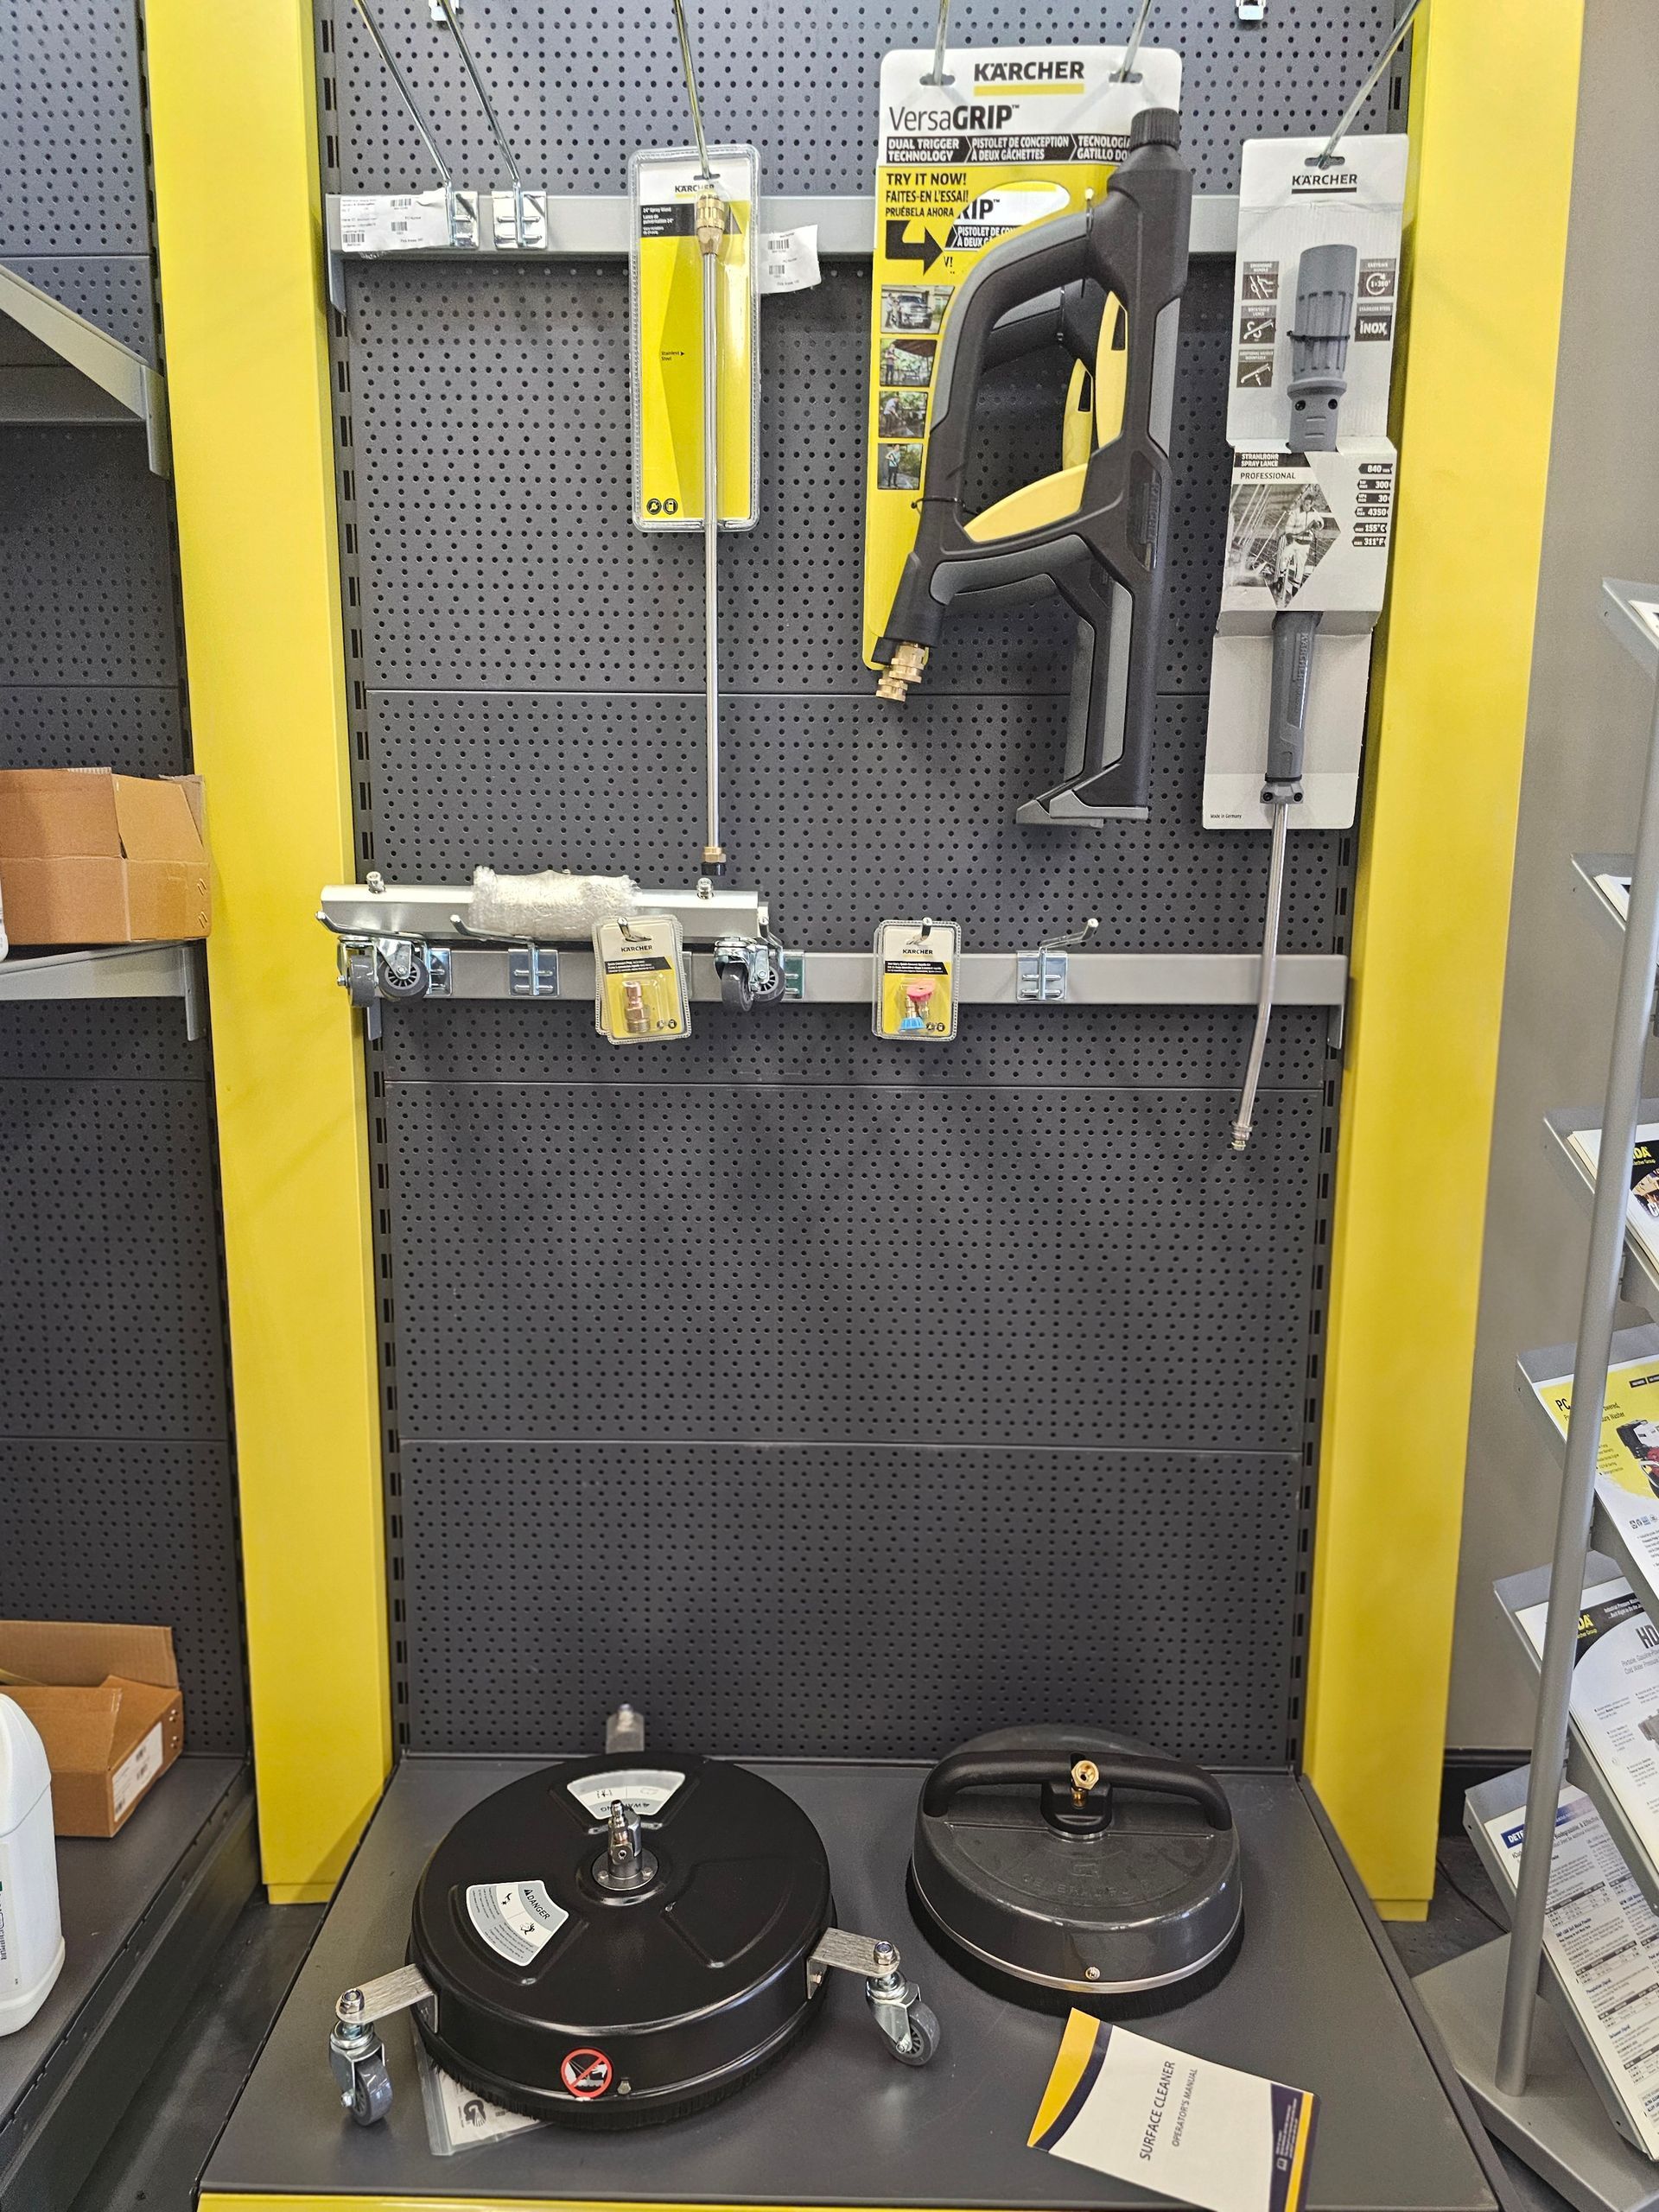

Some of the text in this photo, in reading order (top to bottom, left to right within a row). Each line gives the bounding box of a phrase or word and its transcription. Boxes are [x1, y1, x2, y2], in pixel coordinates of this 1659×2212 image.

[973, 60, 1085, 82] KÄRCHER
[888, 137, 959, 149] DUAL TRIGGER
[971, 136, 1070, 149] PISTOLET DE CONCEPTION
[888, 149, 954, 162] TECHNOLOGY
[979, 149, 1000, 162] DEUX
[1001, 149, 1045, 161] GÂCHETTES
[1077, 148, 1130, 161] GATILLO DO
[887, 173, 966, 185] TRY IT NOW!
[1292, 174, 1357, 186] KÄRCHER
[886, 190, 931, 203] FAITES-EN
[886, 207, 954, 217] PRUÉBELA AHORA
[957, 226, 989, 237] PISTOLET
[990, 226, 1001, 236] DE
[963, 237, 982, 248] DEUX
[1367, 465, 1382, 474] 840
[1376, 480, 1389, 489] 300
[1377, 494, 1388, 503] 30
[1367, 508, 1386, 517] 4350
[1365, 524, 1386, 532] 155°C
[1363, 537, 1384, 546] 311°F
[527, 1895, 550, 1920] DANGER
[1140, 2061, 1175, 2161] SURFACE CLEANER
[1172, 2069, 1198, 2147] OPERATOR'S MANUAL
